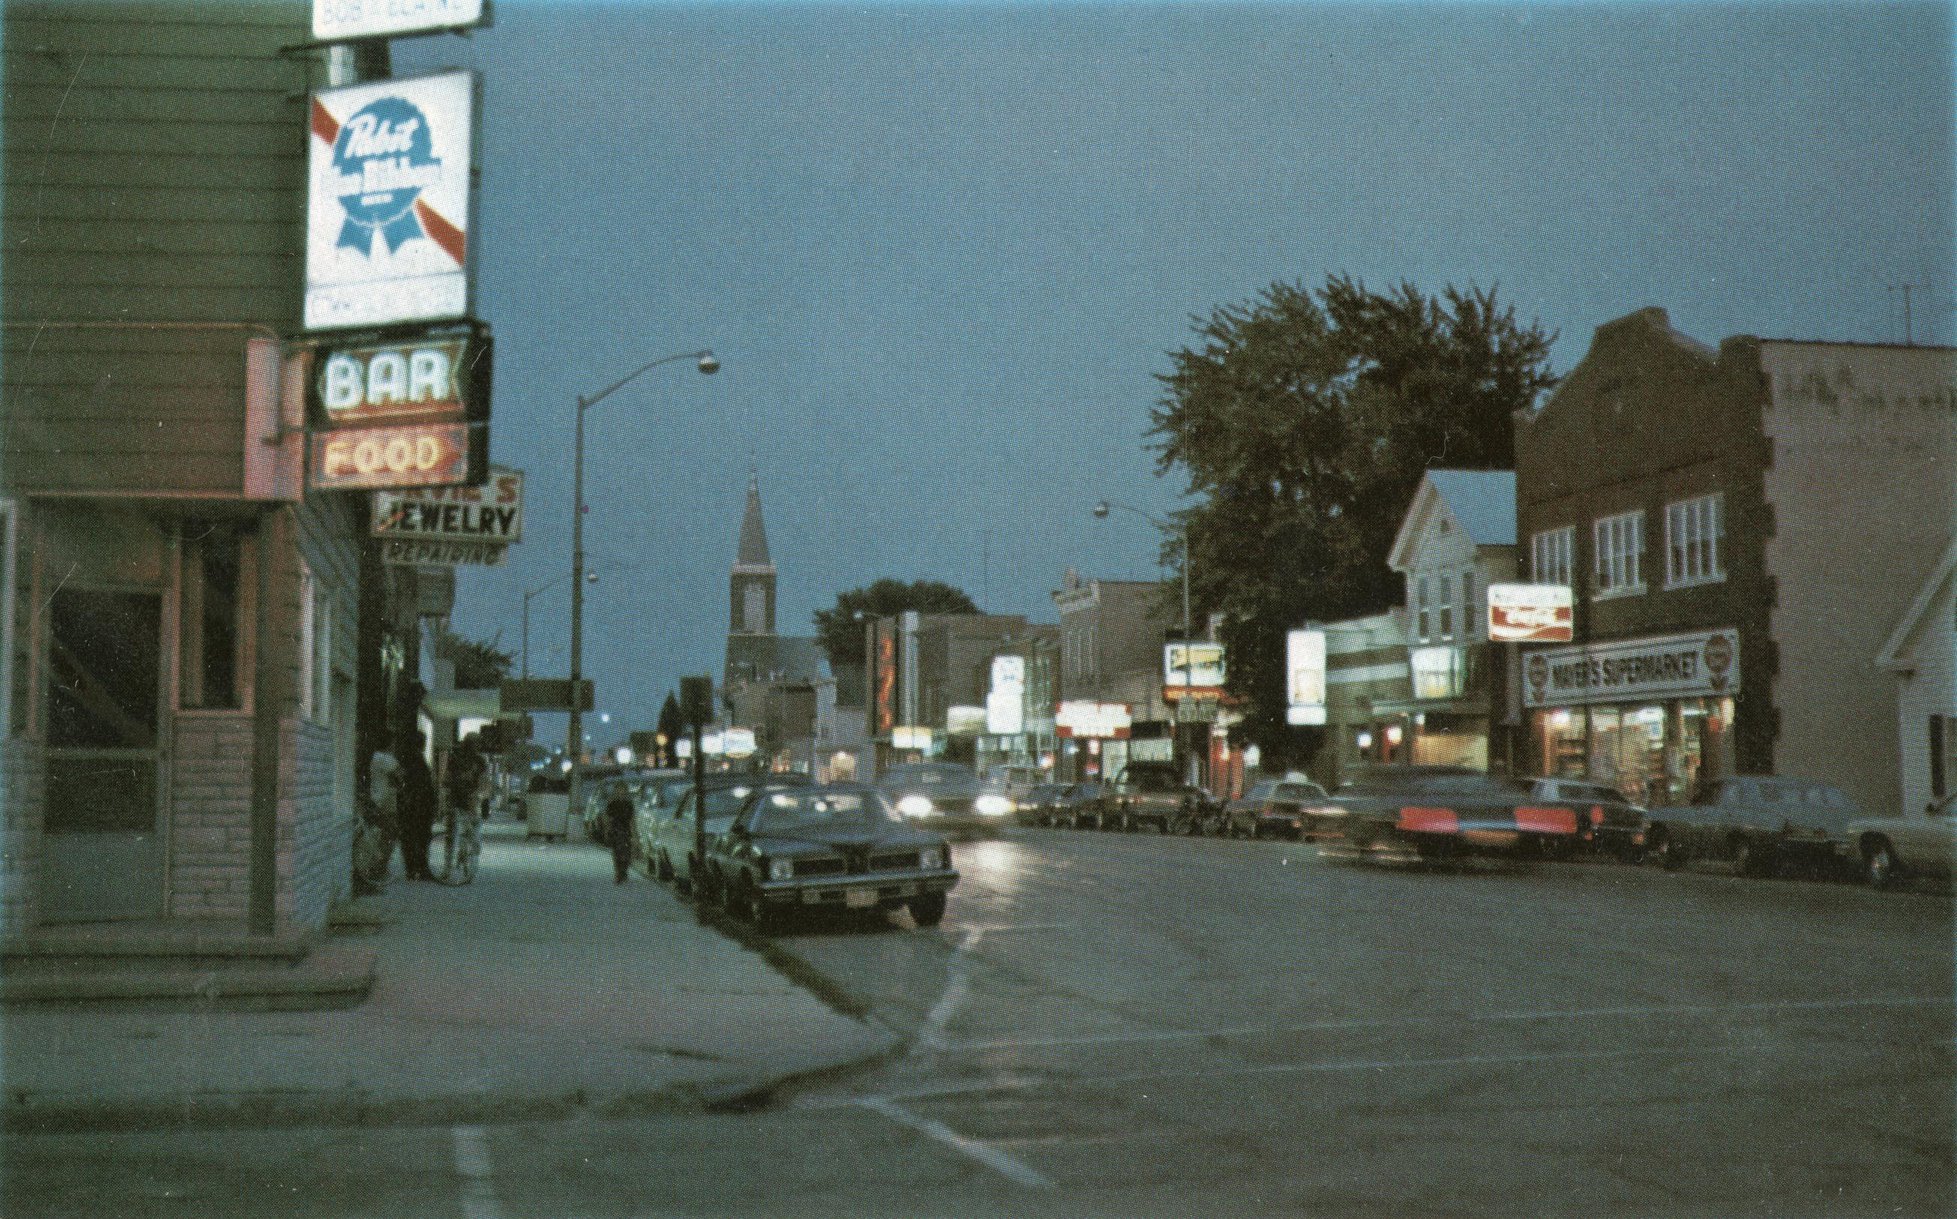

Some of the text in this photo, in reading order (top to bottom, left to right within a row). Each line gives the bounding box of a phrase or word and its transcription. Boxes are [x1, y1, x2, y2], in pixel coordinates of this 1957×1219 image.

[324, 350, 451, 410] BAR
[324, 435, 443, 479] FOOD
[1603, 650, 1698, 686] SUPERMARKET
